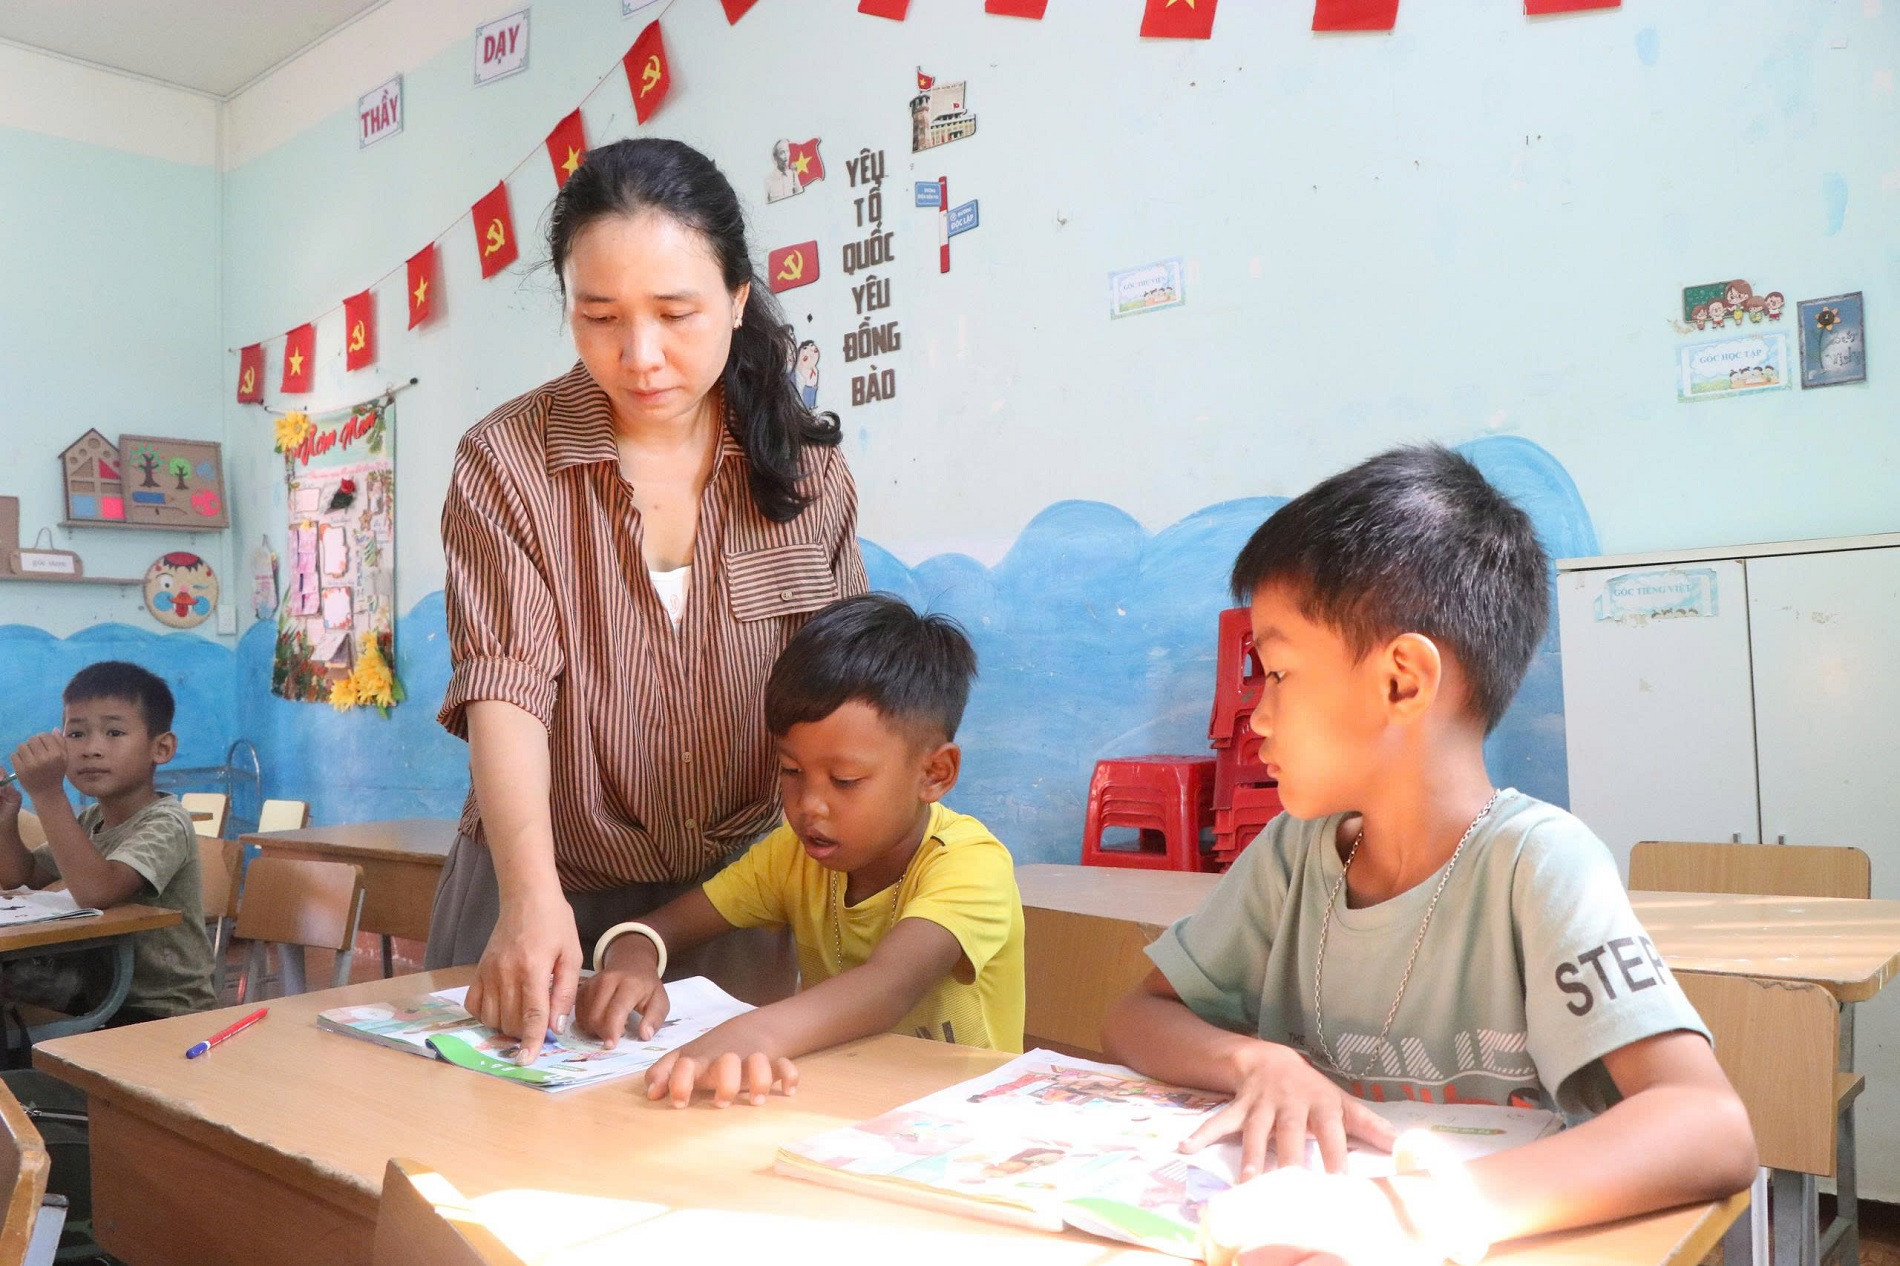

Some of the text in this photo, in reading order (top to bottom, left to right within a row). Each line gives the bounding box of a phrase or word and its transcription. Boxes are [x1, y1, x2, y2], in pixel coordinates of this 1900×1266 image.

[482, 24, 520, 64] DẠY
[361, 89, 399, 138] THẦY
[845, 147, 885, 188] YÊU
[842, 221, 895, 275] QUỐC
[851, 274, 890, 315] YÊU
[842, 315, 901, 363] ĐỒNG
[1699, 353, 1717, 364] GÓC
[1721, 351, 1741, 361] HỌC
[851, 364, 896, 407] BÀO
[1613, 587, 1634, 597] GÓC
